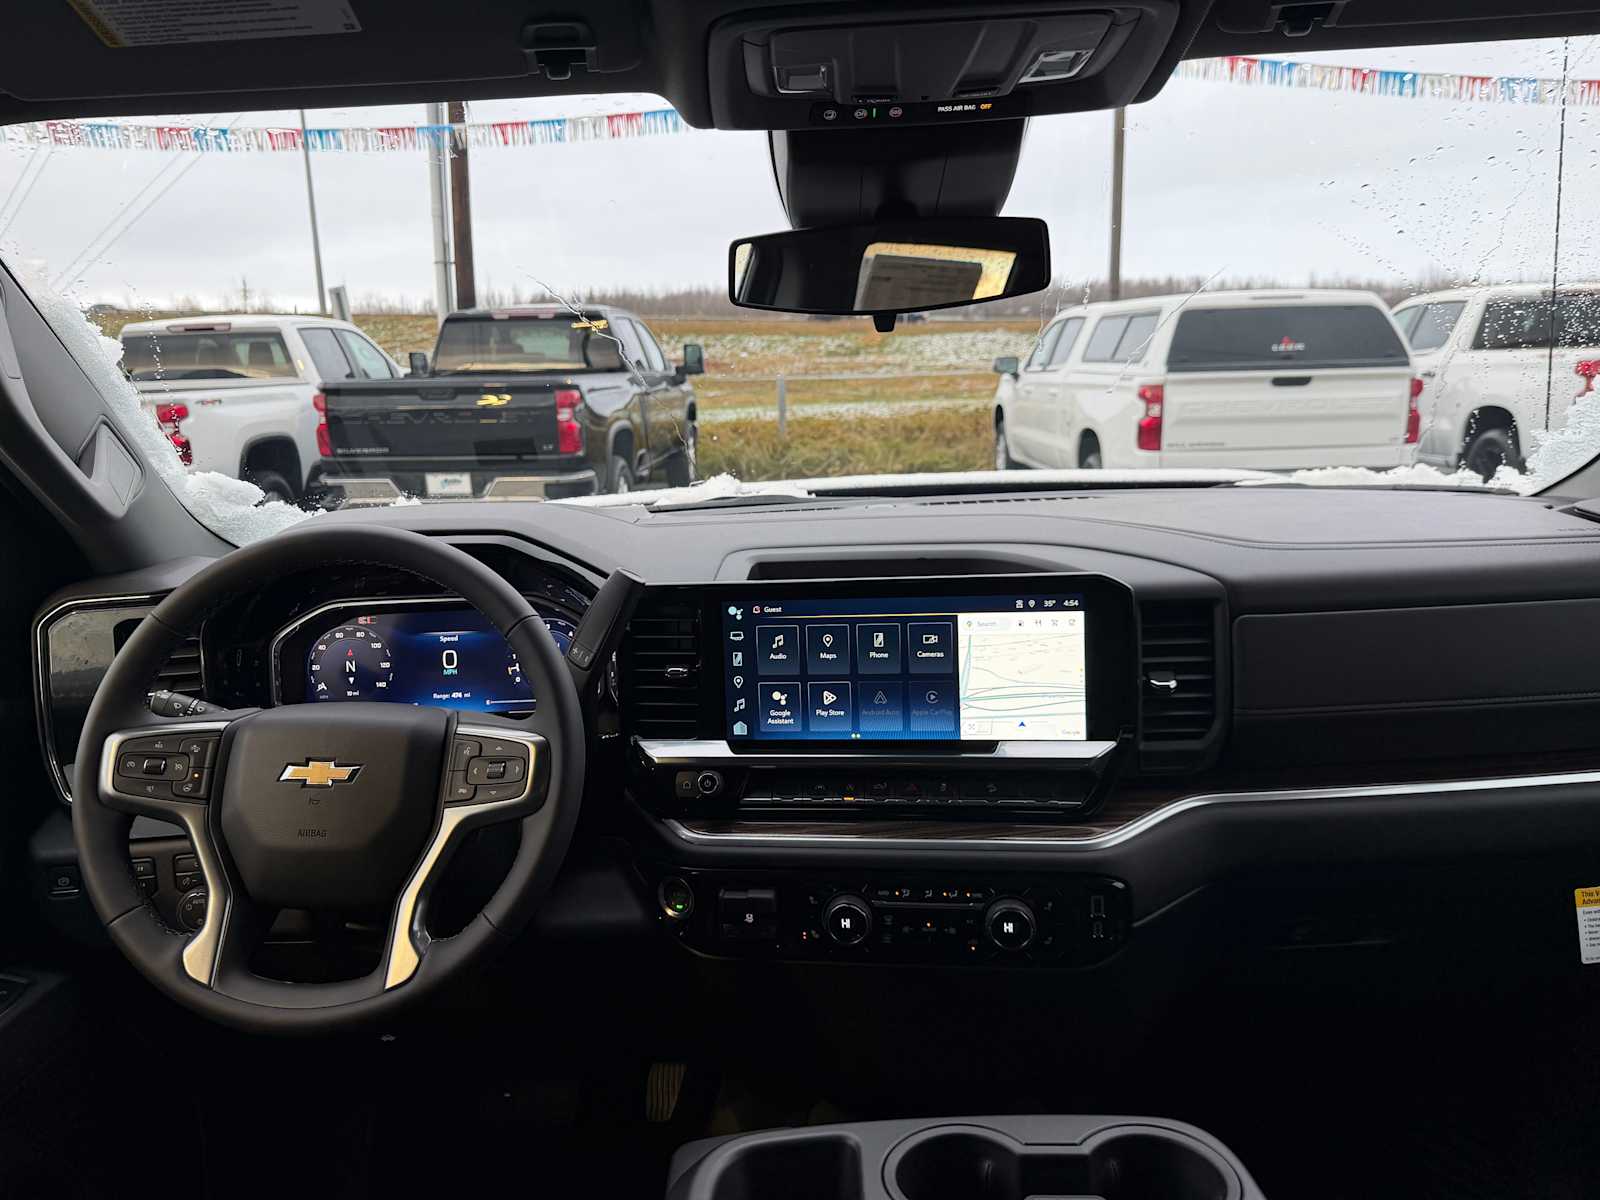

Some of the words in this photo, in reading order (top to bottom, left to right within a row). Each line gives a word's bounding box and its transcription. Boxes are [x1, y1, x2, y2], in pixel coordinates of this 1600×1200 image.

[1063, 599, 1079, 607] 4:54
[439, 635, 459, 643] Speed
[769, 652, 787, 660] Audio
[820, 652, 837, 660] Maps
[869, 651, 889, 659] Phone
[916, 650, 945, 658] Cameras
[442, 649, 458, 669] 0
[345, 660, 356, 673] N
[769, 709, 791, 717] Google
[816, 709, 829, 717] Play
[767, 717, 794, 725] Assistant
[297, 829, 328, 839] AIRBAG
